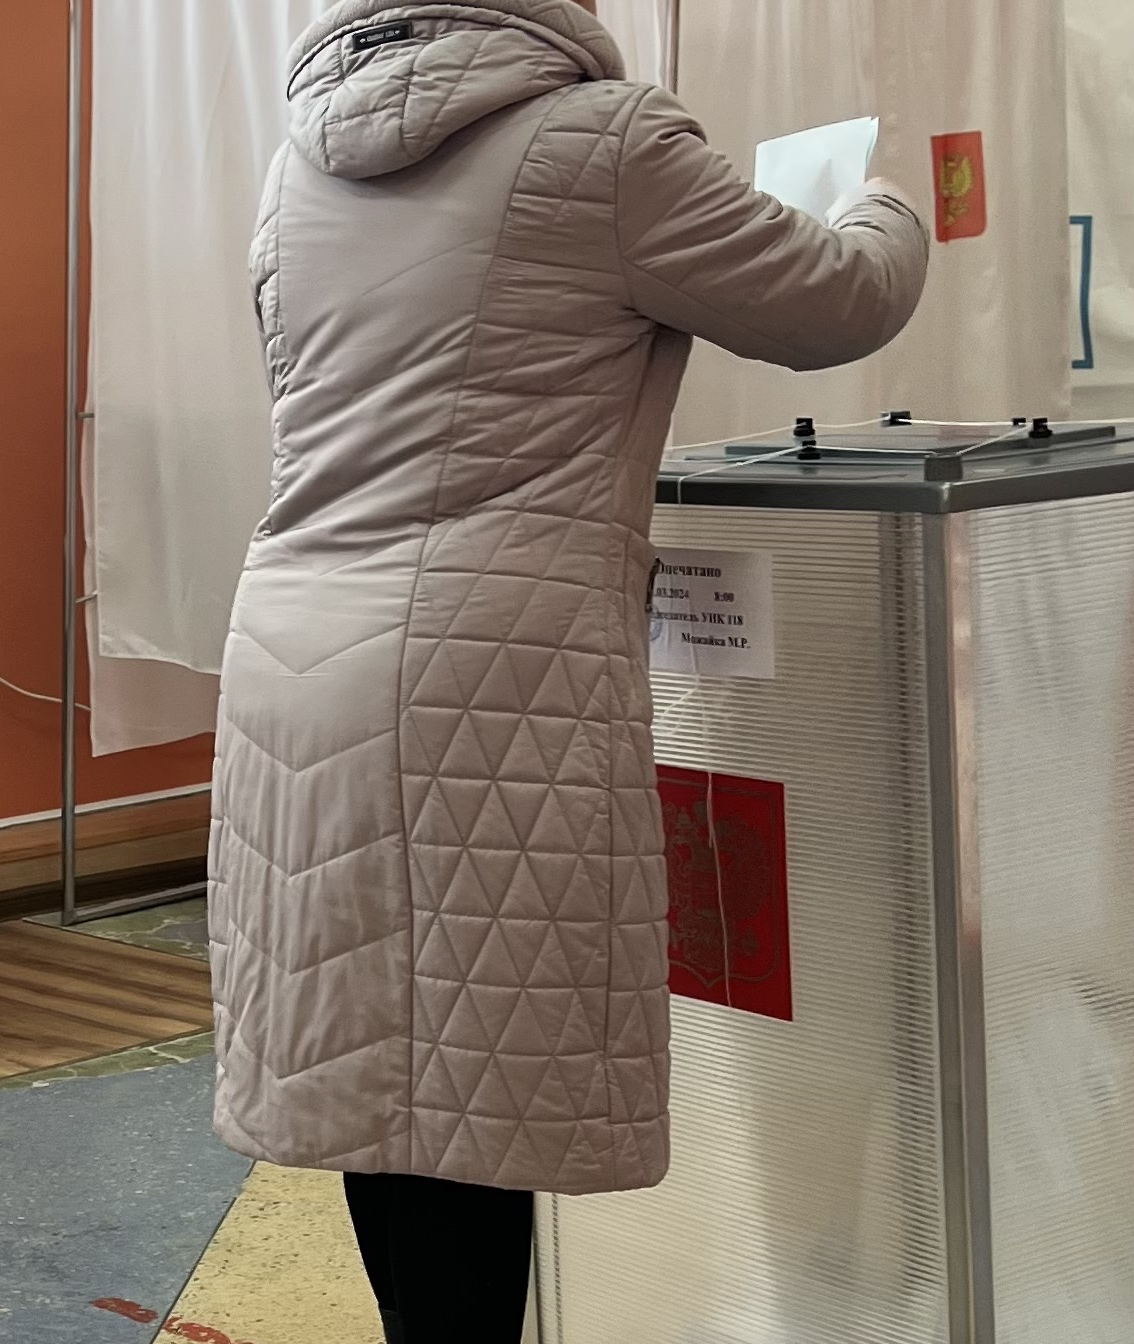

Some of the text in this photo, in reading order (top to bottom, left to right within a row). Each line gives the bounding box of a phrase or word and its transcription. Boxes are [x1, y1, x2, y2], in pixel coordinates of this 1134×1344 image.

[714, 591, 734, 602] 8:00
[701, 612, 725, 625] УИК
[728, 614, 744, 626] 118
